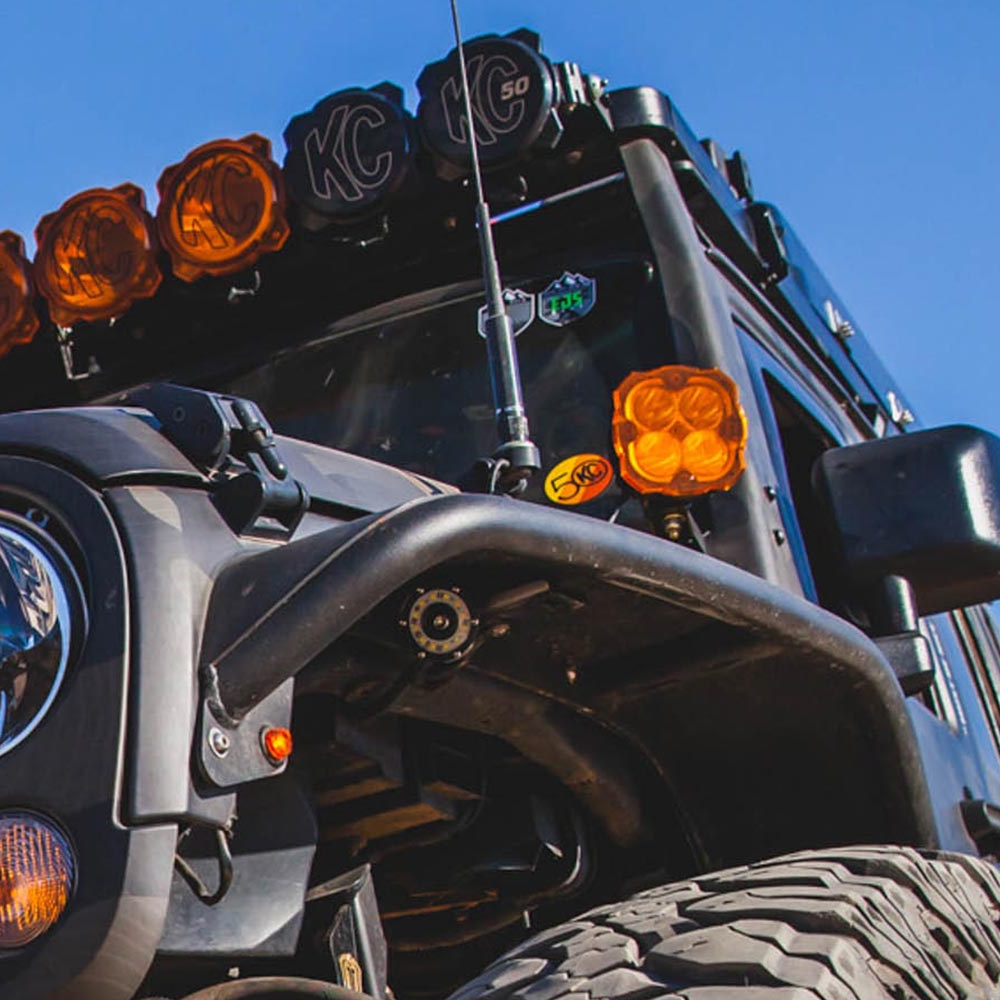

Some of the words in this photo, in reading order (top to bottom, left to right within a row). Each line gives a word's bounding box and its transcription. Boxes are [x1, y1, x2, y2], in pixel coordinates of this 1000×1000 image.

[440, 54, 525, 146] KC
[500, 76, 530, 100] 50
[304, 104, 392, 201] KC
